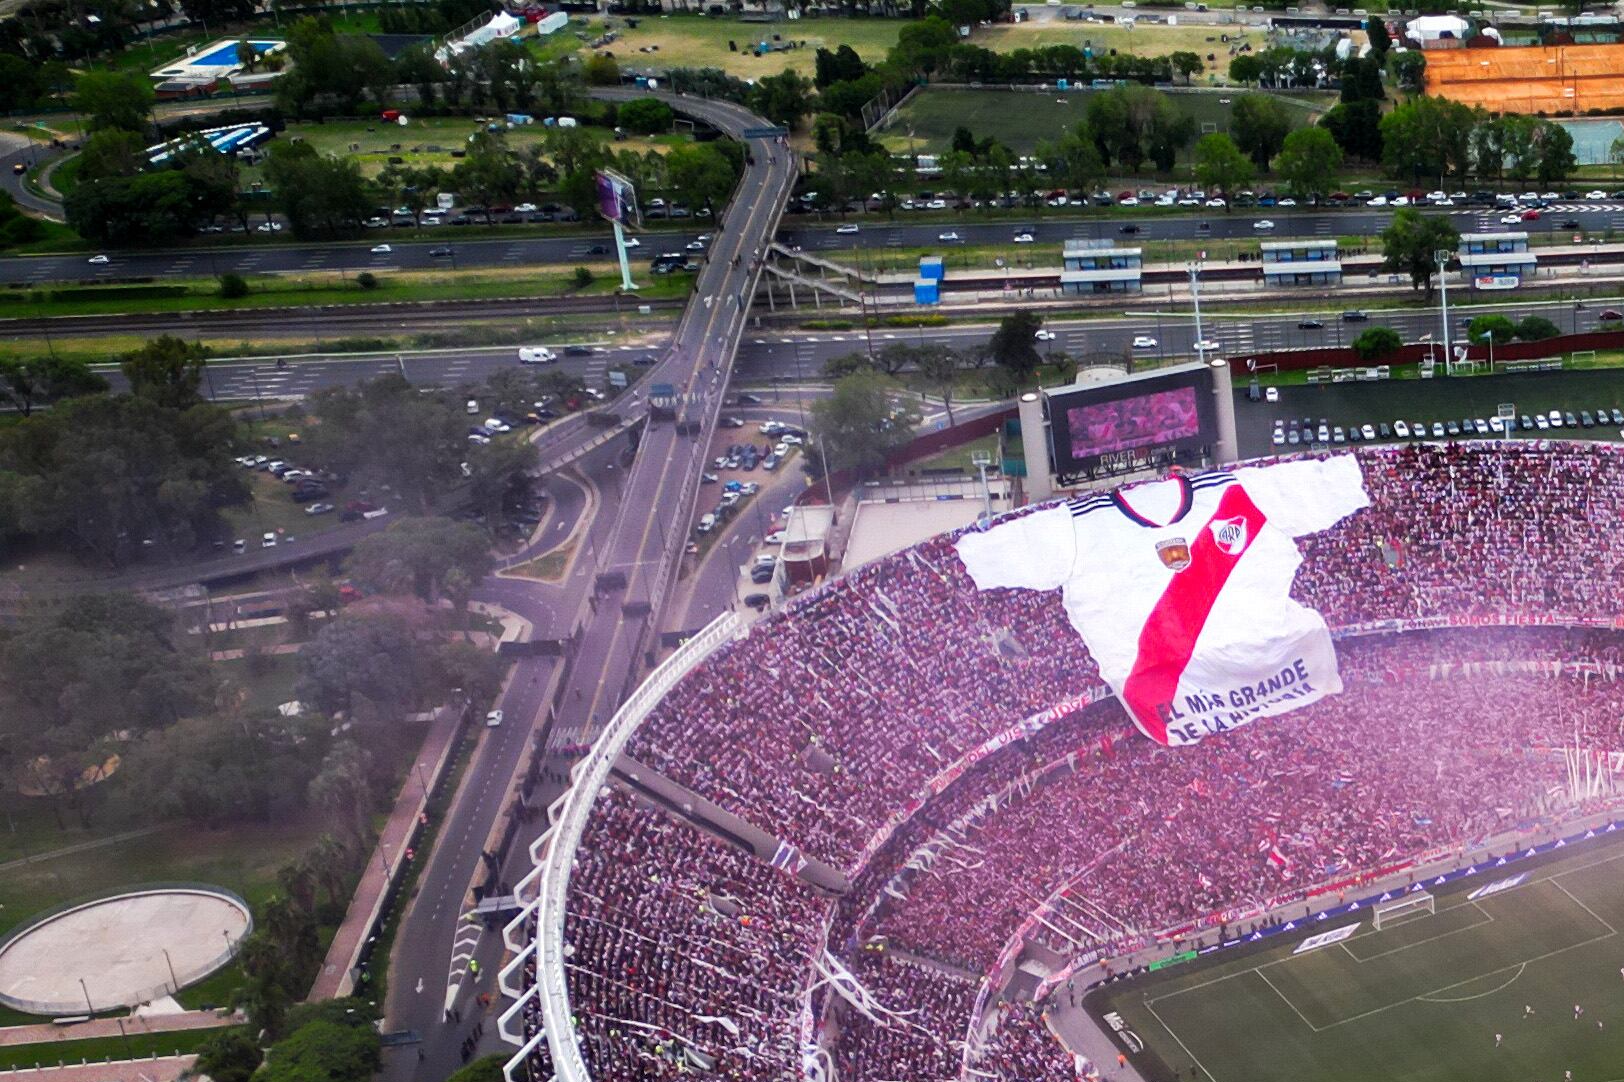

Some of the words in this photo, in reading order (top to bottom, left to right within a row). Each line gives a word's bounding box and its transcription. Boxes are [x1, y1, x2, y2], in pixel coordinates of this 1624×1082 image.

[1450, 613, 1499, 625] SOMOS
[1506, 613, 1555, 625] FIESTA
[1156, 702, 1184, 723] EL
[1229, 658, 1309, 708] GRANDE
